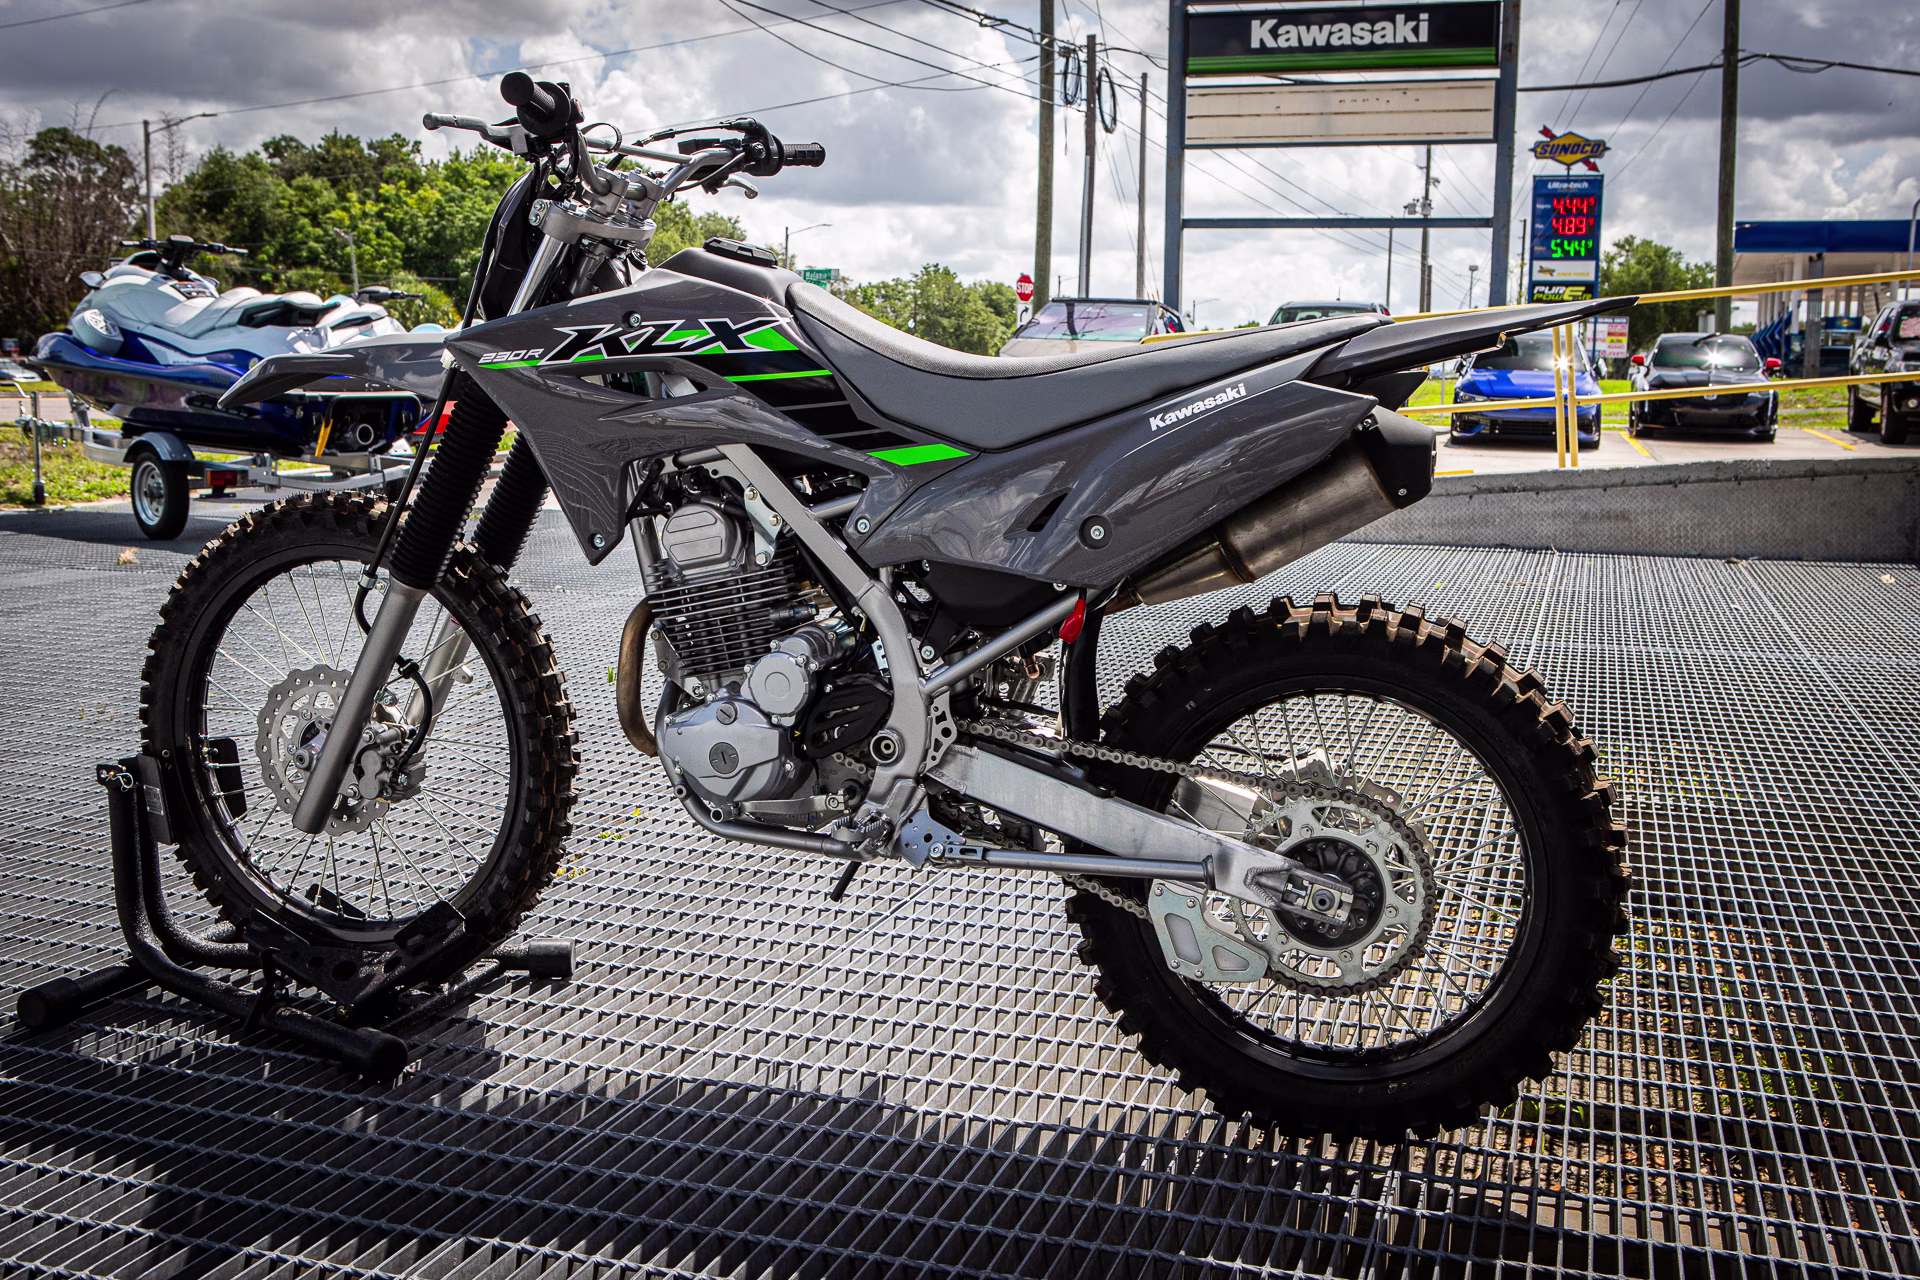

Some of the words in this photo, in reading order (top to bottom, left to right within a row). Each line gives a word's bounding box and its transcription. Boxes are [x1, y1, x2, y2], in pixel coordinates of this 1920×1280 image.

[1251, 13, 1429, 48] Kawasaki
[1539, 143, 1602, 155] SUNOCO
[1017, 282, 1034, 294] STOP
[478, 348, 545, 364] 230R
[539, 315, 794, 366] KLX
[1149, 383, 1247, 431] Kawasaki
